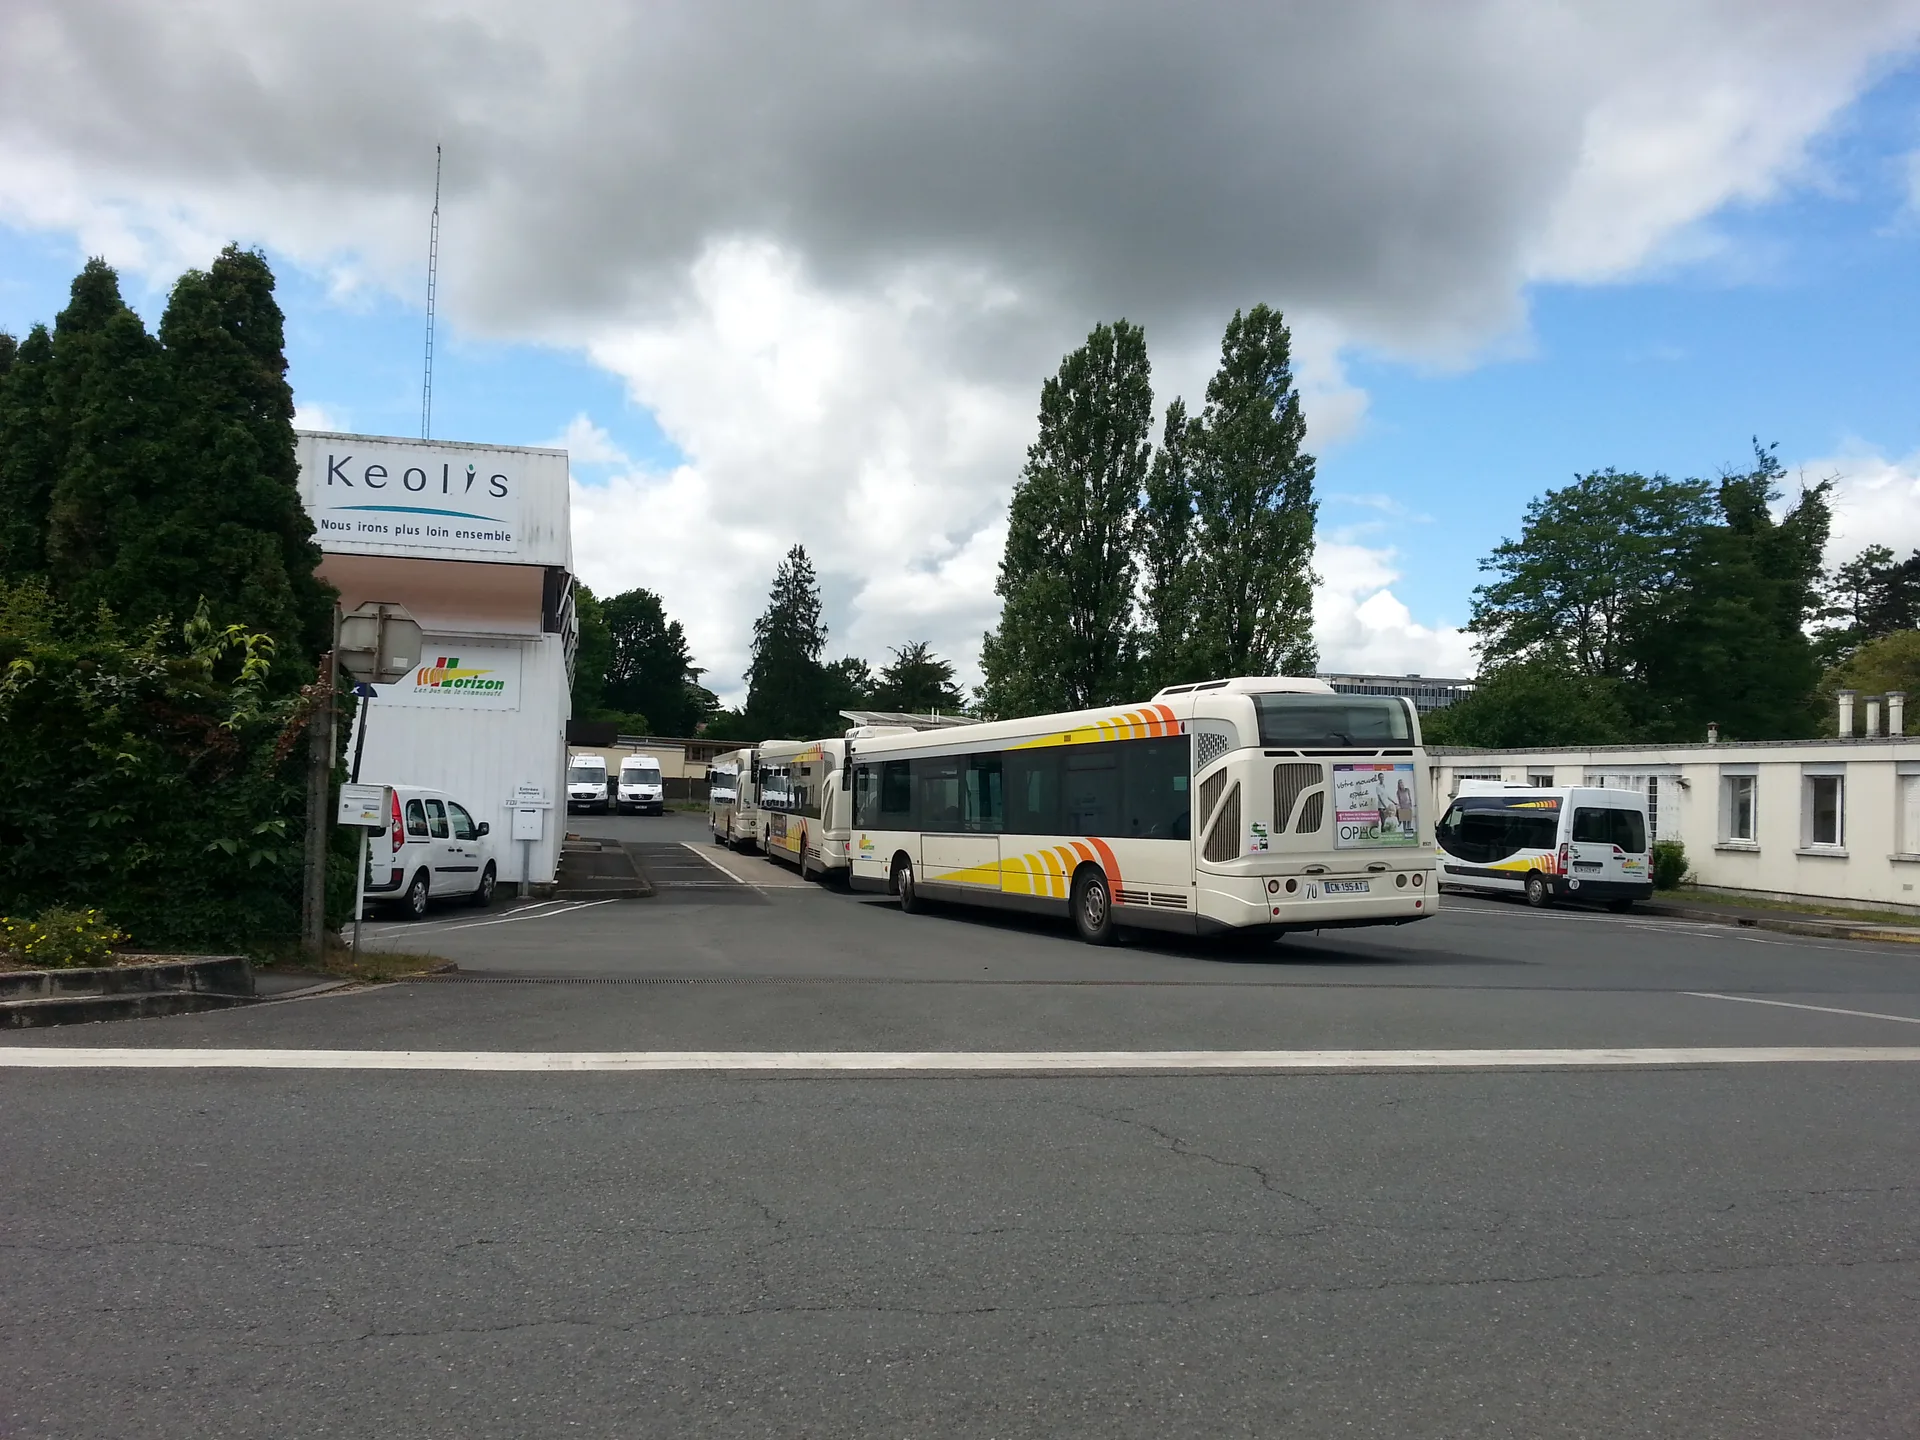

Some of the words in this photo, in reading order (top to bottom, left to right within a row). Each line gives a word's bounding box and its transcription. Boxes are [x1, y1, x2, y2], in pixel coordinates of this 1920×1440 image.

[327, 454, 509, 498] Keolis
[321, 518, 351, 531] Nous
[357, 521, 388, 534] irons
[395, 523, 420, 537] plus
[426, 525, 449, 538] loin
[455, 529, 511, 542] ensemble
[1349, 801, 1357, 810] de
[1306, 883, 1318, 899] 70
[1571, 879, 1578, 888] 70
